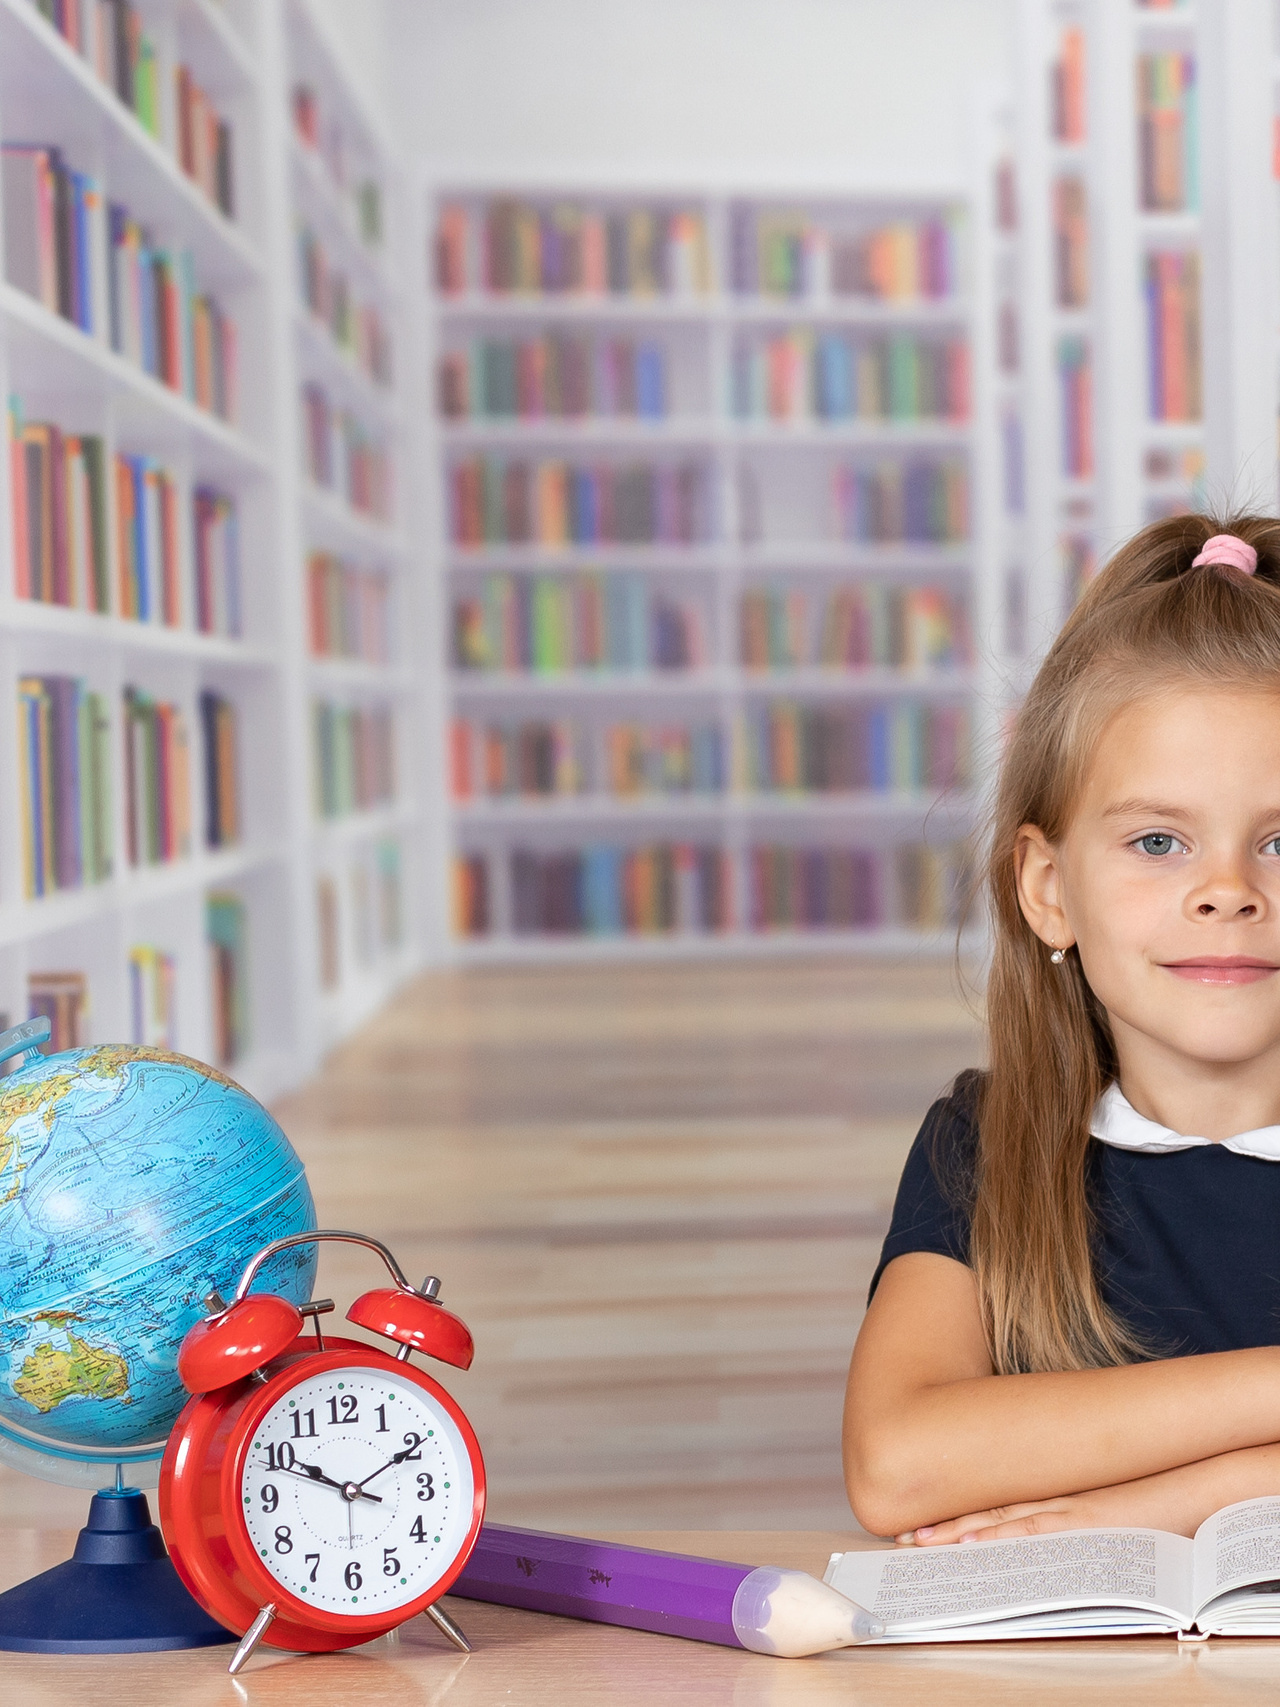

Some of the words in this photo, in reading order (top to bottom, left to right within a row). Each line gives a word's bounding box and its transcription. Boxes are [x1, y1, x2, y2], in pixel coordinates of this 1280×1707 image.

[289, 1408, 320, 1439] 11
[326, 1394, 359, 1425] 12
[374, 1403, 390, 1433] 1
[263, 1441, 295, 1472] 10
[403, 1432, 422, 1461] 2
[260, 1483, 279, 1514] 9
[416, 1473, 435, 1501] 3
[275, 1525, 293, 1555] 8
[409, 1515, 427, 1544] 4
[304, 1553, 320, 1583] 7
[344, 1561, 363, 1591] 6
[383, 1547, 401, 1577] 5
